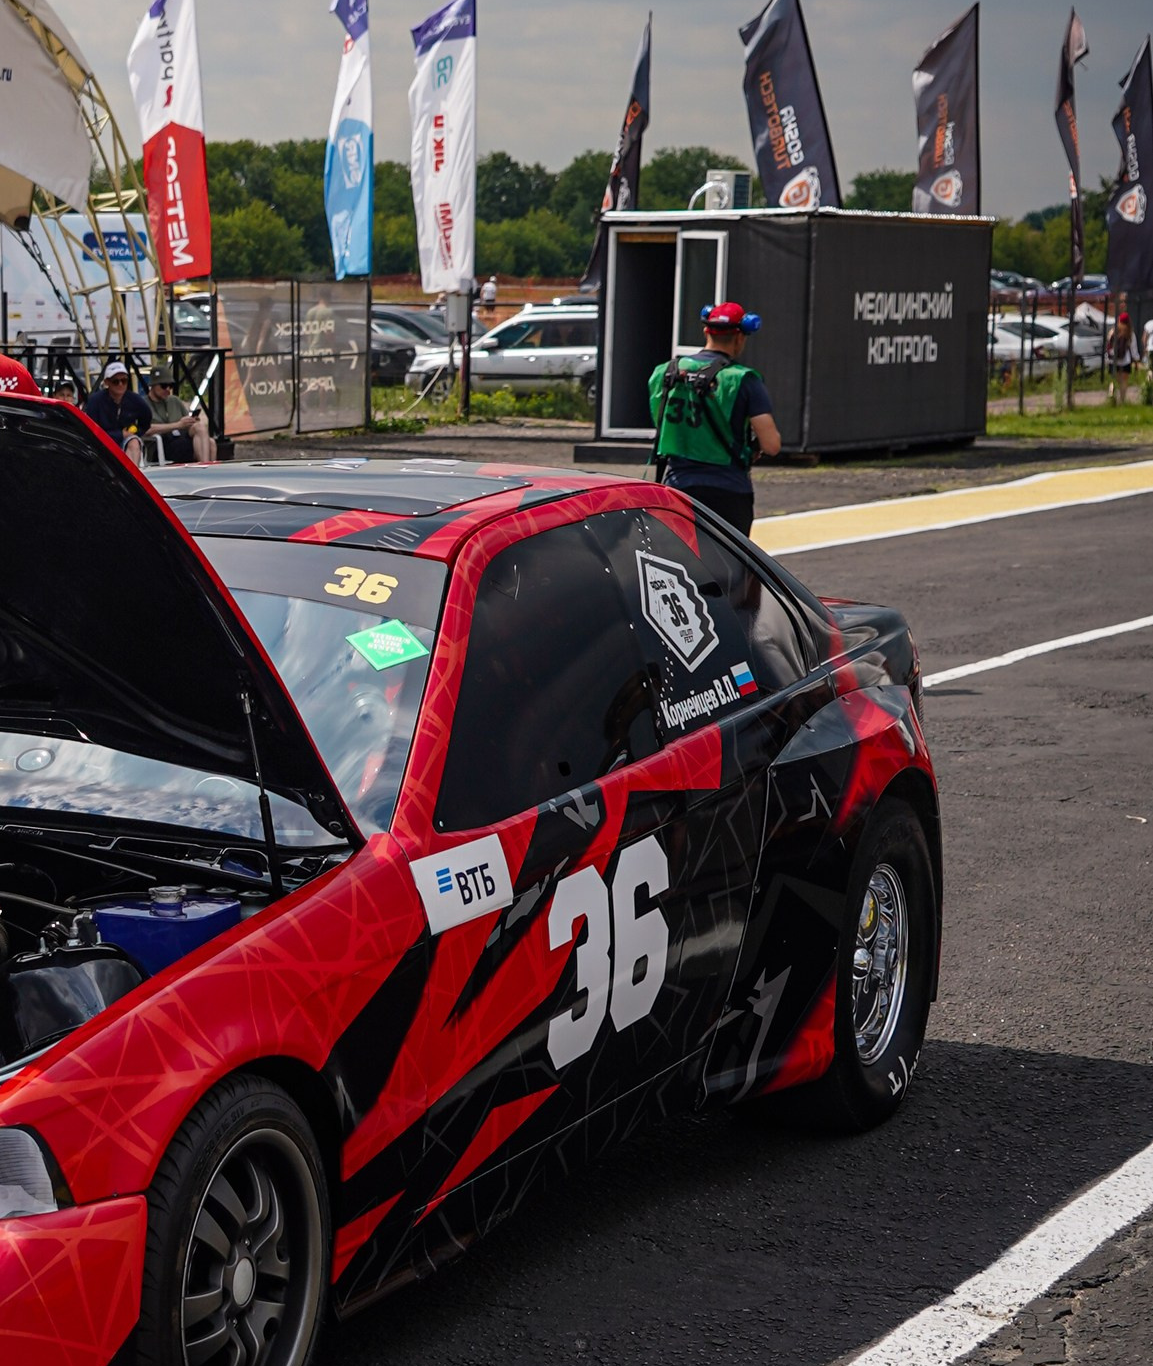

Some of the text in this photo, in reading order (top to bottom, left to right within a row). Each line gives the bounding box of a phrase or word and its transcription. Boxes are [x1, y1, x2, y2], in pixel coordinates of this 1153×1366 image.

[854, 282, 953, 325] МЕДИЦИНСКИЙ
[867, 335, 938, 365] КОНТРОЛЬ
[665, 397, 703, 428] 33
[323, 565, 399, 604] 36
[661, 592, 690, 628] 36
[659, 675, 741, 730] Корнейцев В.П.
[454, 862, 497, 906] ВТБ
[547, 834, 670, 1071] 36
